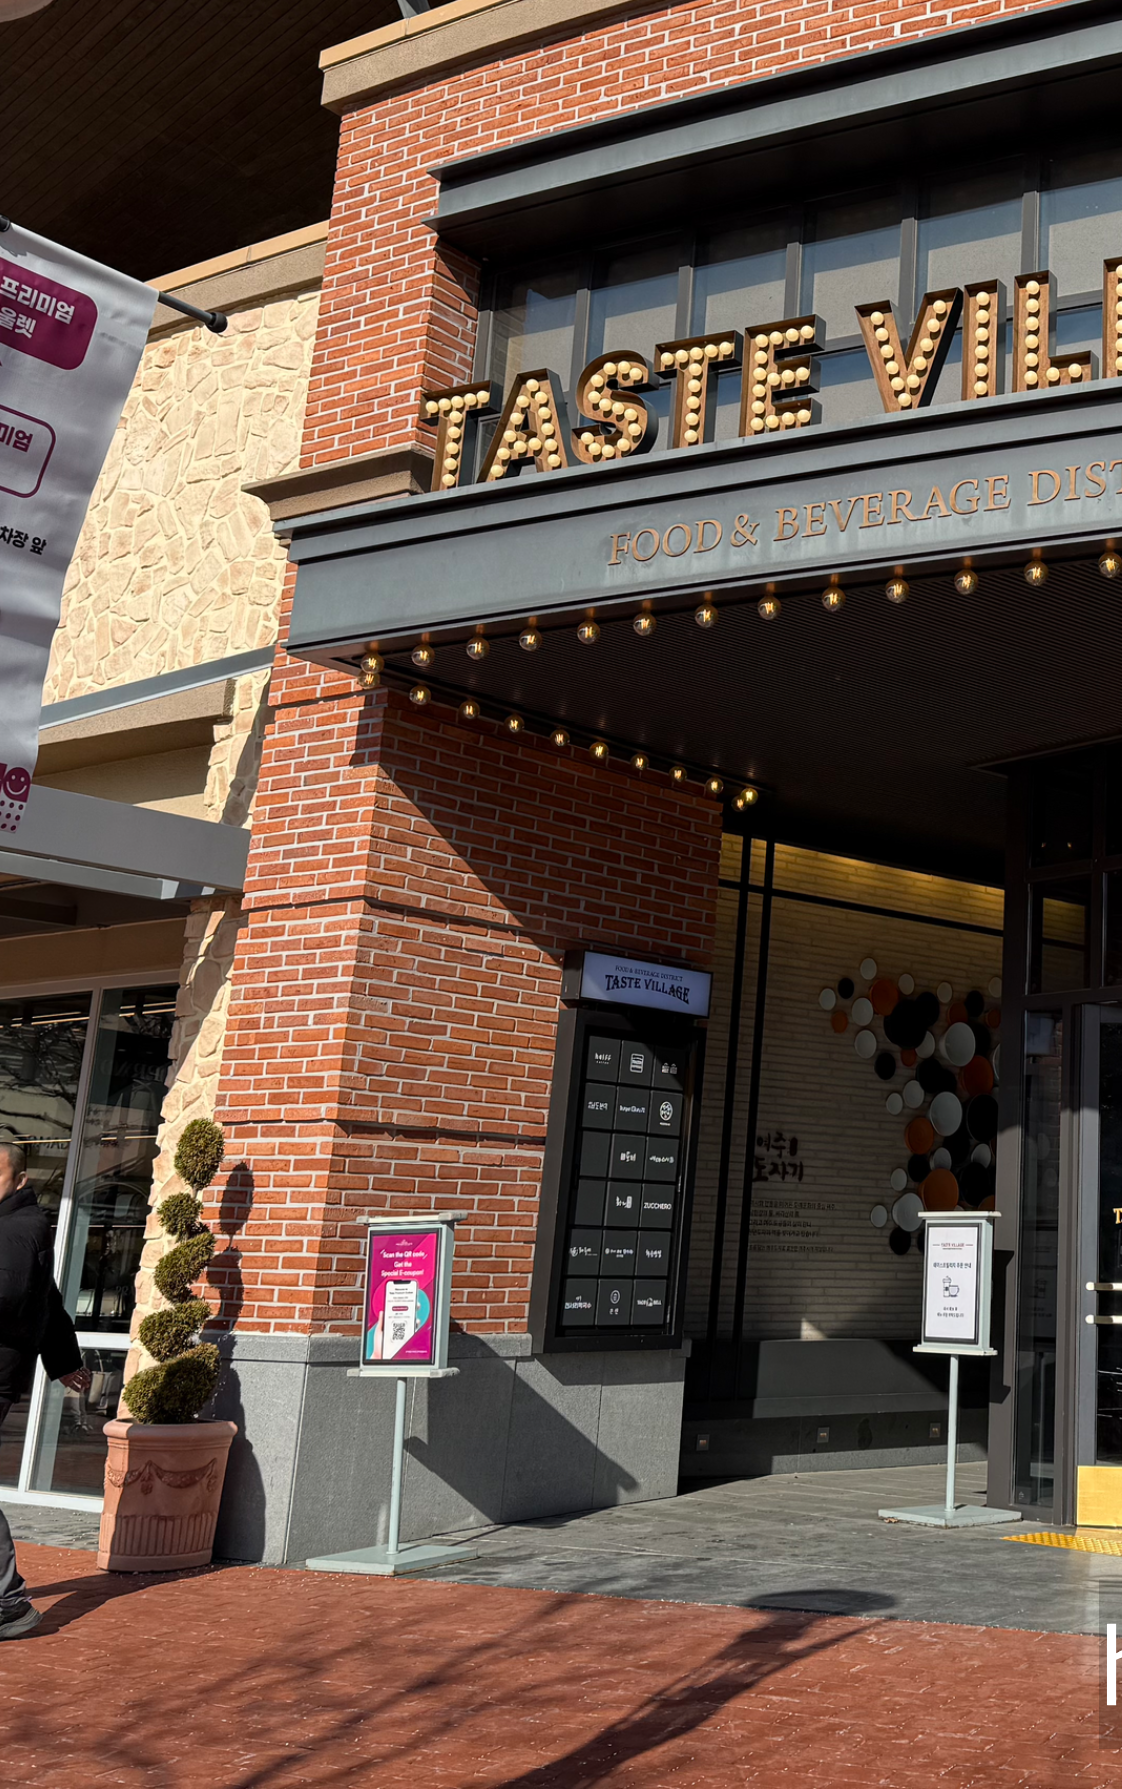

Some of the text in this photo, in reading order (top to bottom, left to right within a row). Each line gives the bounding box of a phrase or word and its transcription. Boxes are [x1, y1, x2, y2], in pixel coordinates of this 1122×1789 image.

[0, 276, 75, 325] 프리미엄
[421, 314, 826, 492] TASTE
[608, 519, 723, 566] FOOD
[730, 513, 760, 548] &
[773, 474, 1012, 542] BEVERAGE
[30, 536, 47, 555] 앞
[605, 974, 690, 1005] TASTE VILLAGE
[644, 1202, 672, 1210] ZUCCHERO
[381, 1270, 398, 1278] Special
